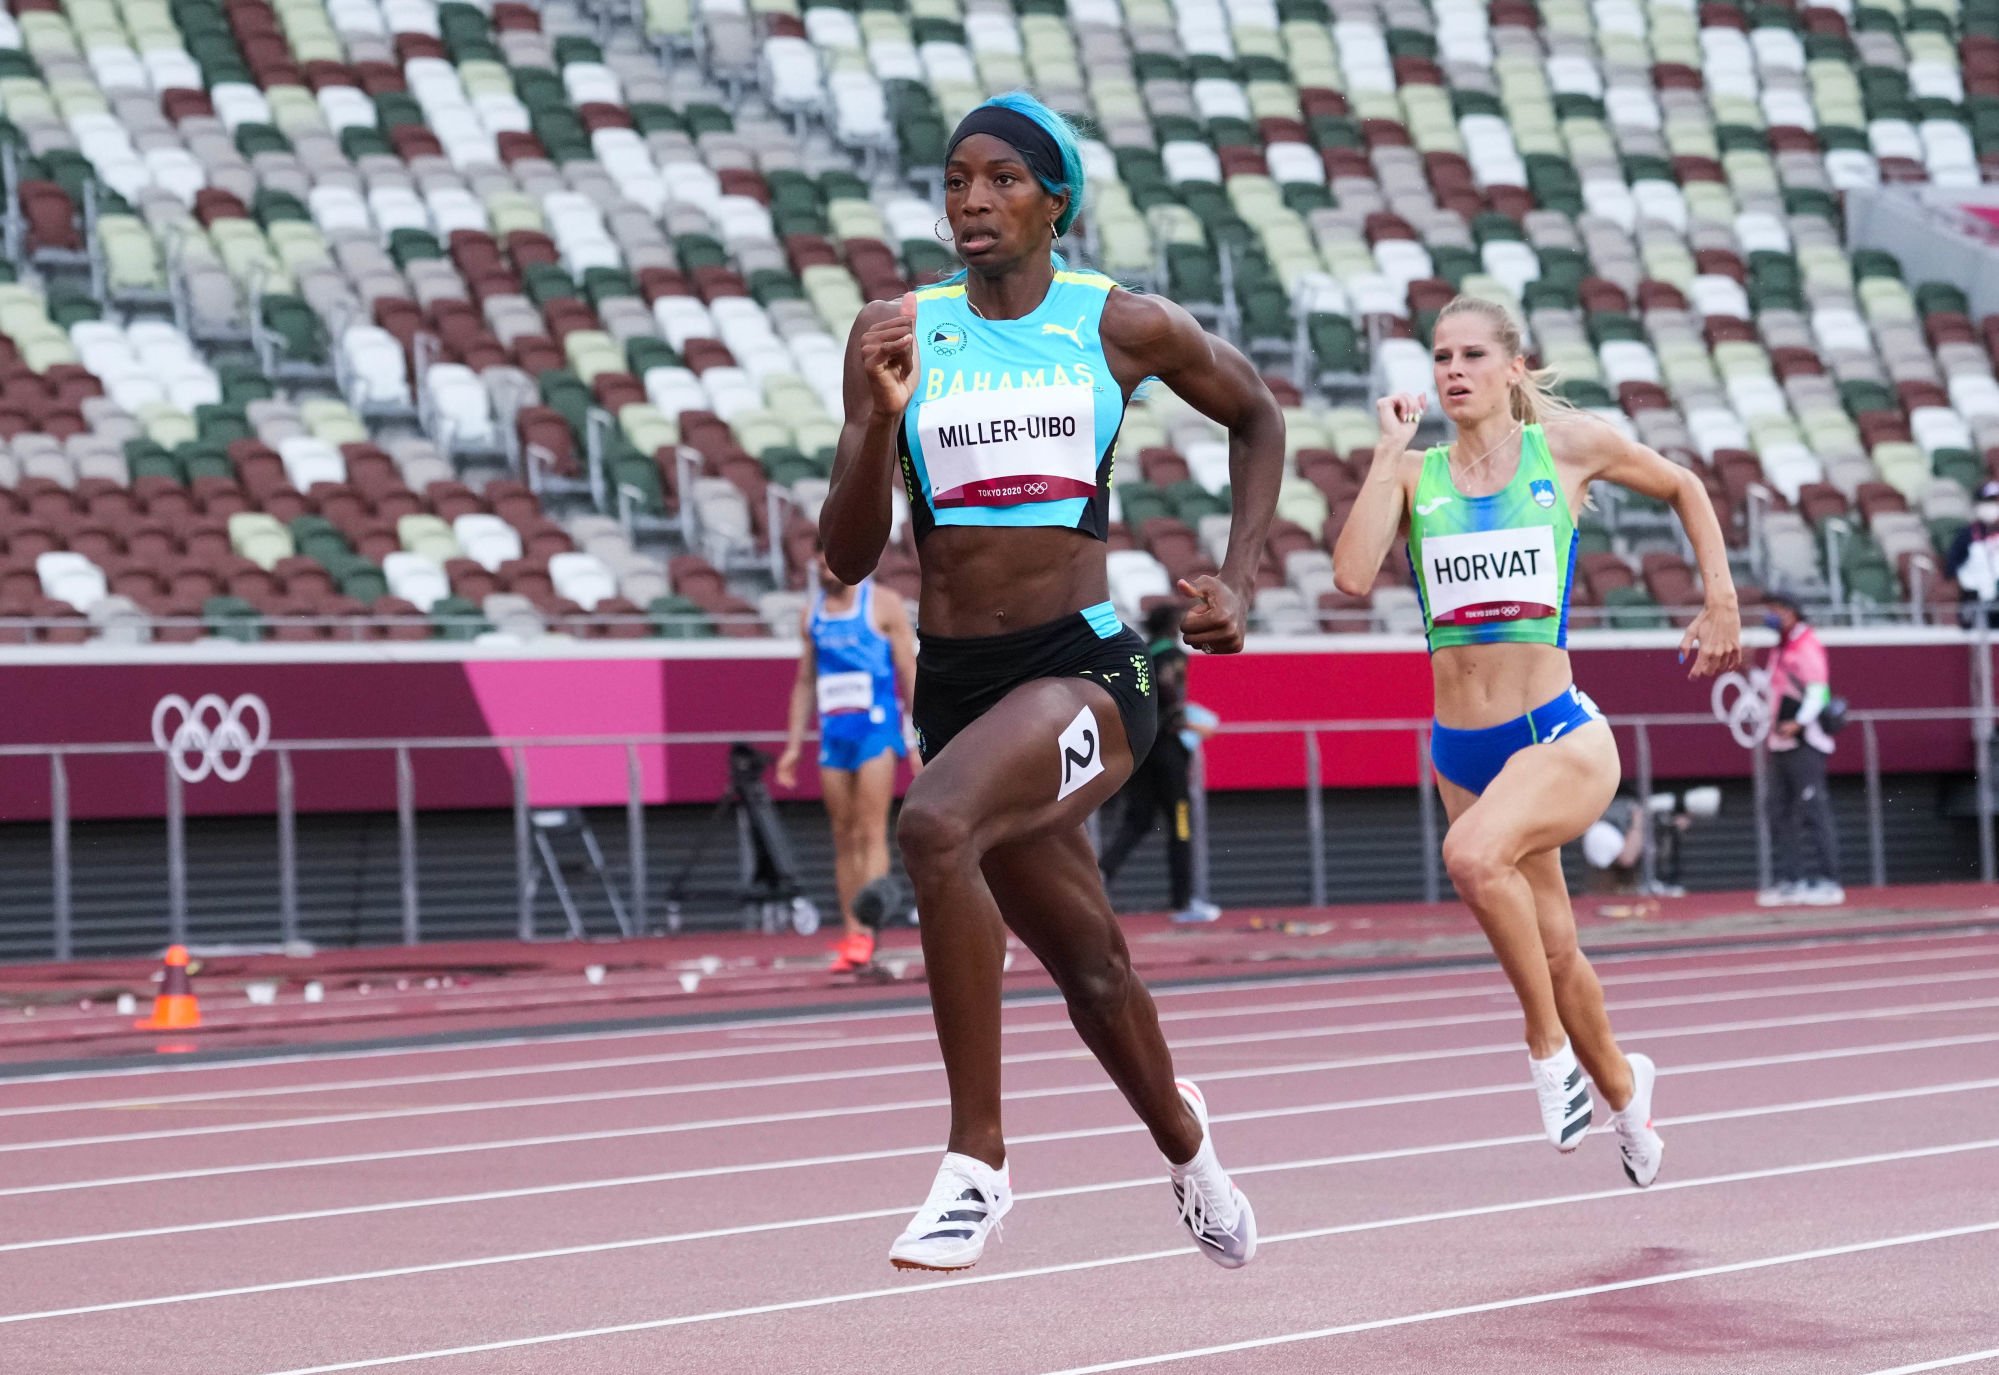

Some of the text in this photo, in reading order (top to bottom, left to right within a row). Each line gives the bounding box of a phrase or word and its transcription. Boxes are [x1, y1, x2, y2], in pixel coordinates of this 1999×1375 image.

[926, 363, 1095, 401] BAHAMAS
[938, 416, 1076, 448] MILLER-UIBO
[978, 486, 1022, 497] TOKYO 2020
[1434, 548, 1541, 584] HORVAT
[1465, 610, 1485, 619] TOKYO
[1065, 729, 1095, 784] 2
